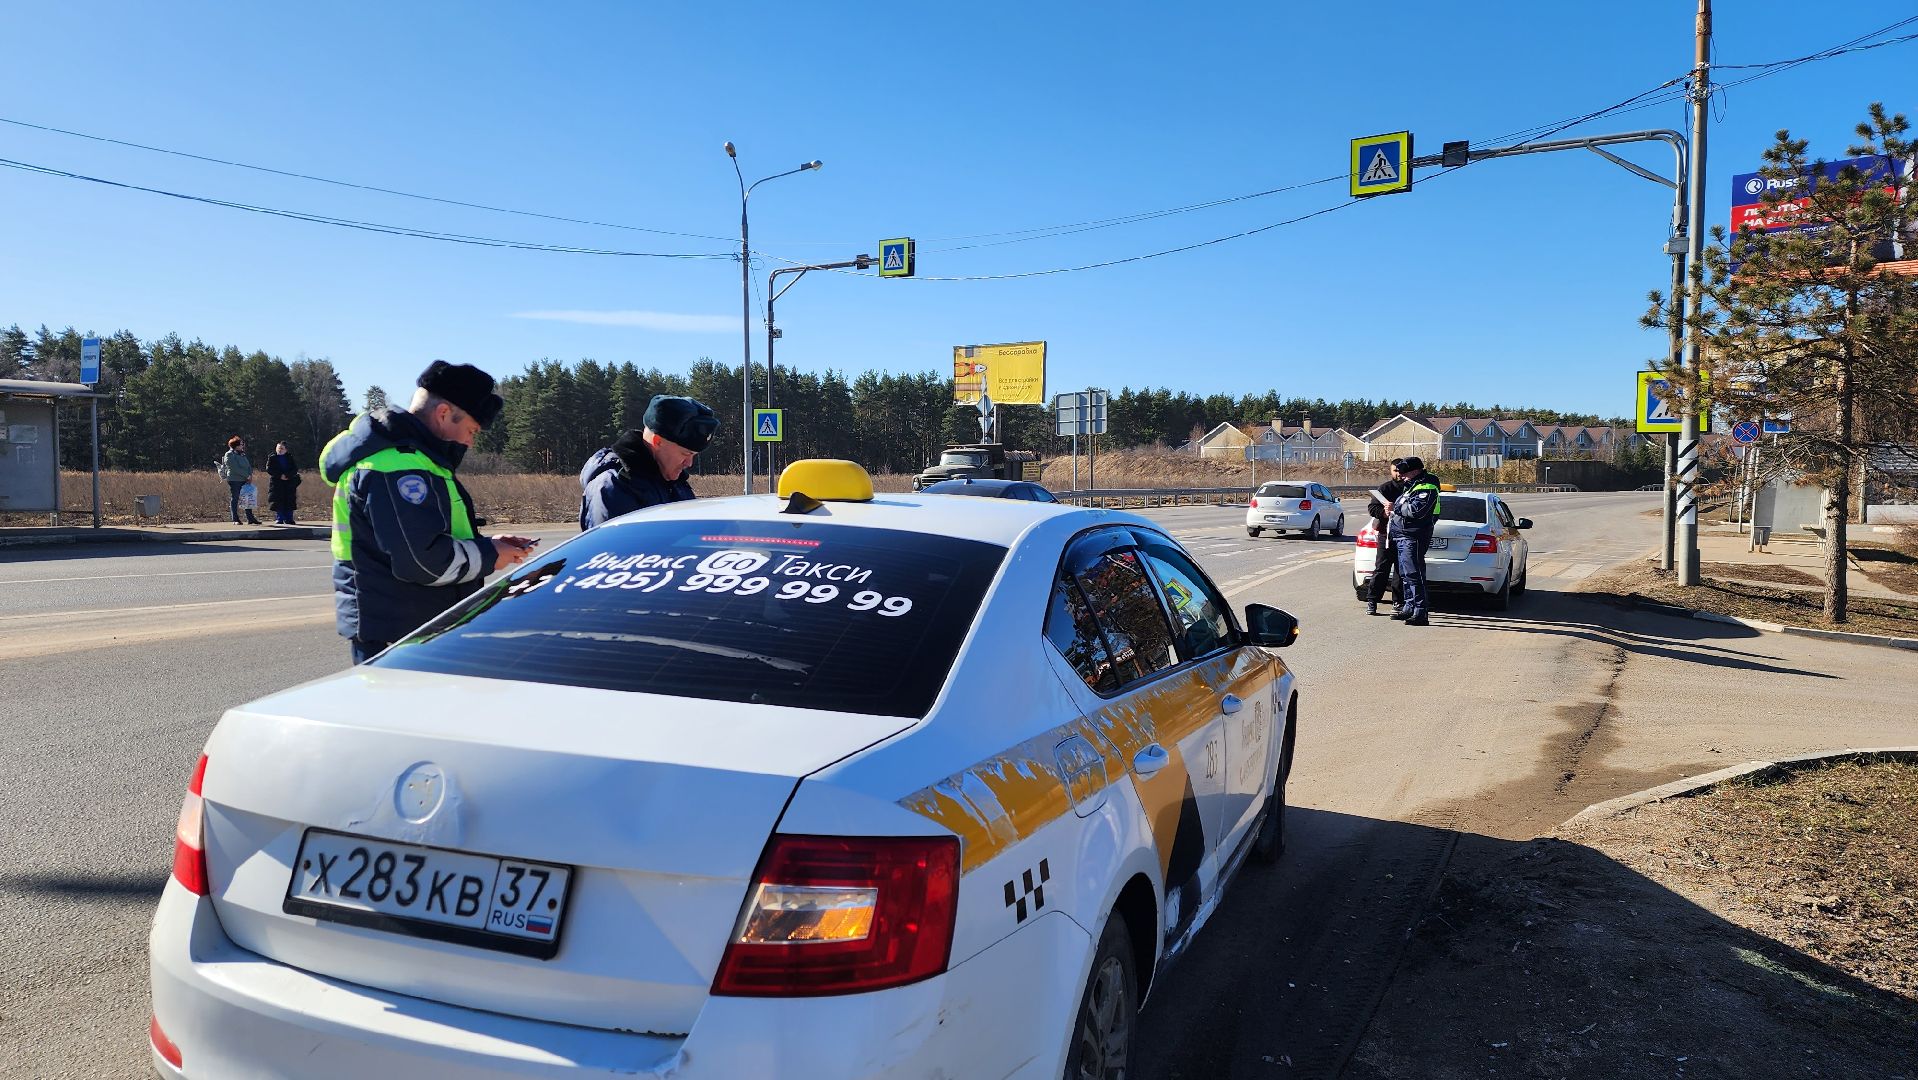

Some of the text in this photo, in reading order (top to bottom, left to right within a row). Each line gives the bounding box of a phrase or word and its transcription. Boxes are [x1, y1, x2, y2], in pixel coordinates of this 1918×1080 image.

[1744, 203, 1803, 216] ЛЬОТЫ
[576, 551, 699, 571] Яндекс
[771, 554, 873, 584] Такси
[677, 573, 770, 596] 999
[774, 580, 840, 604] 99
[846, 590, 914, 617] 99
[500, 866, 550, 912] 37
[491, 909, 526, 930] RUS
